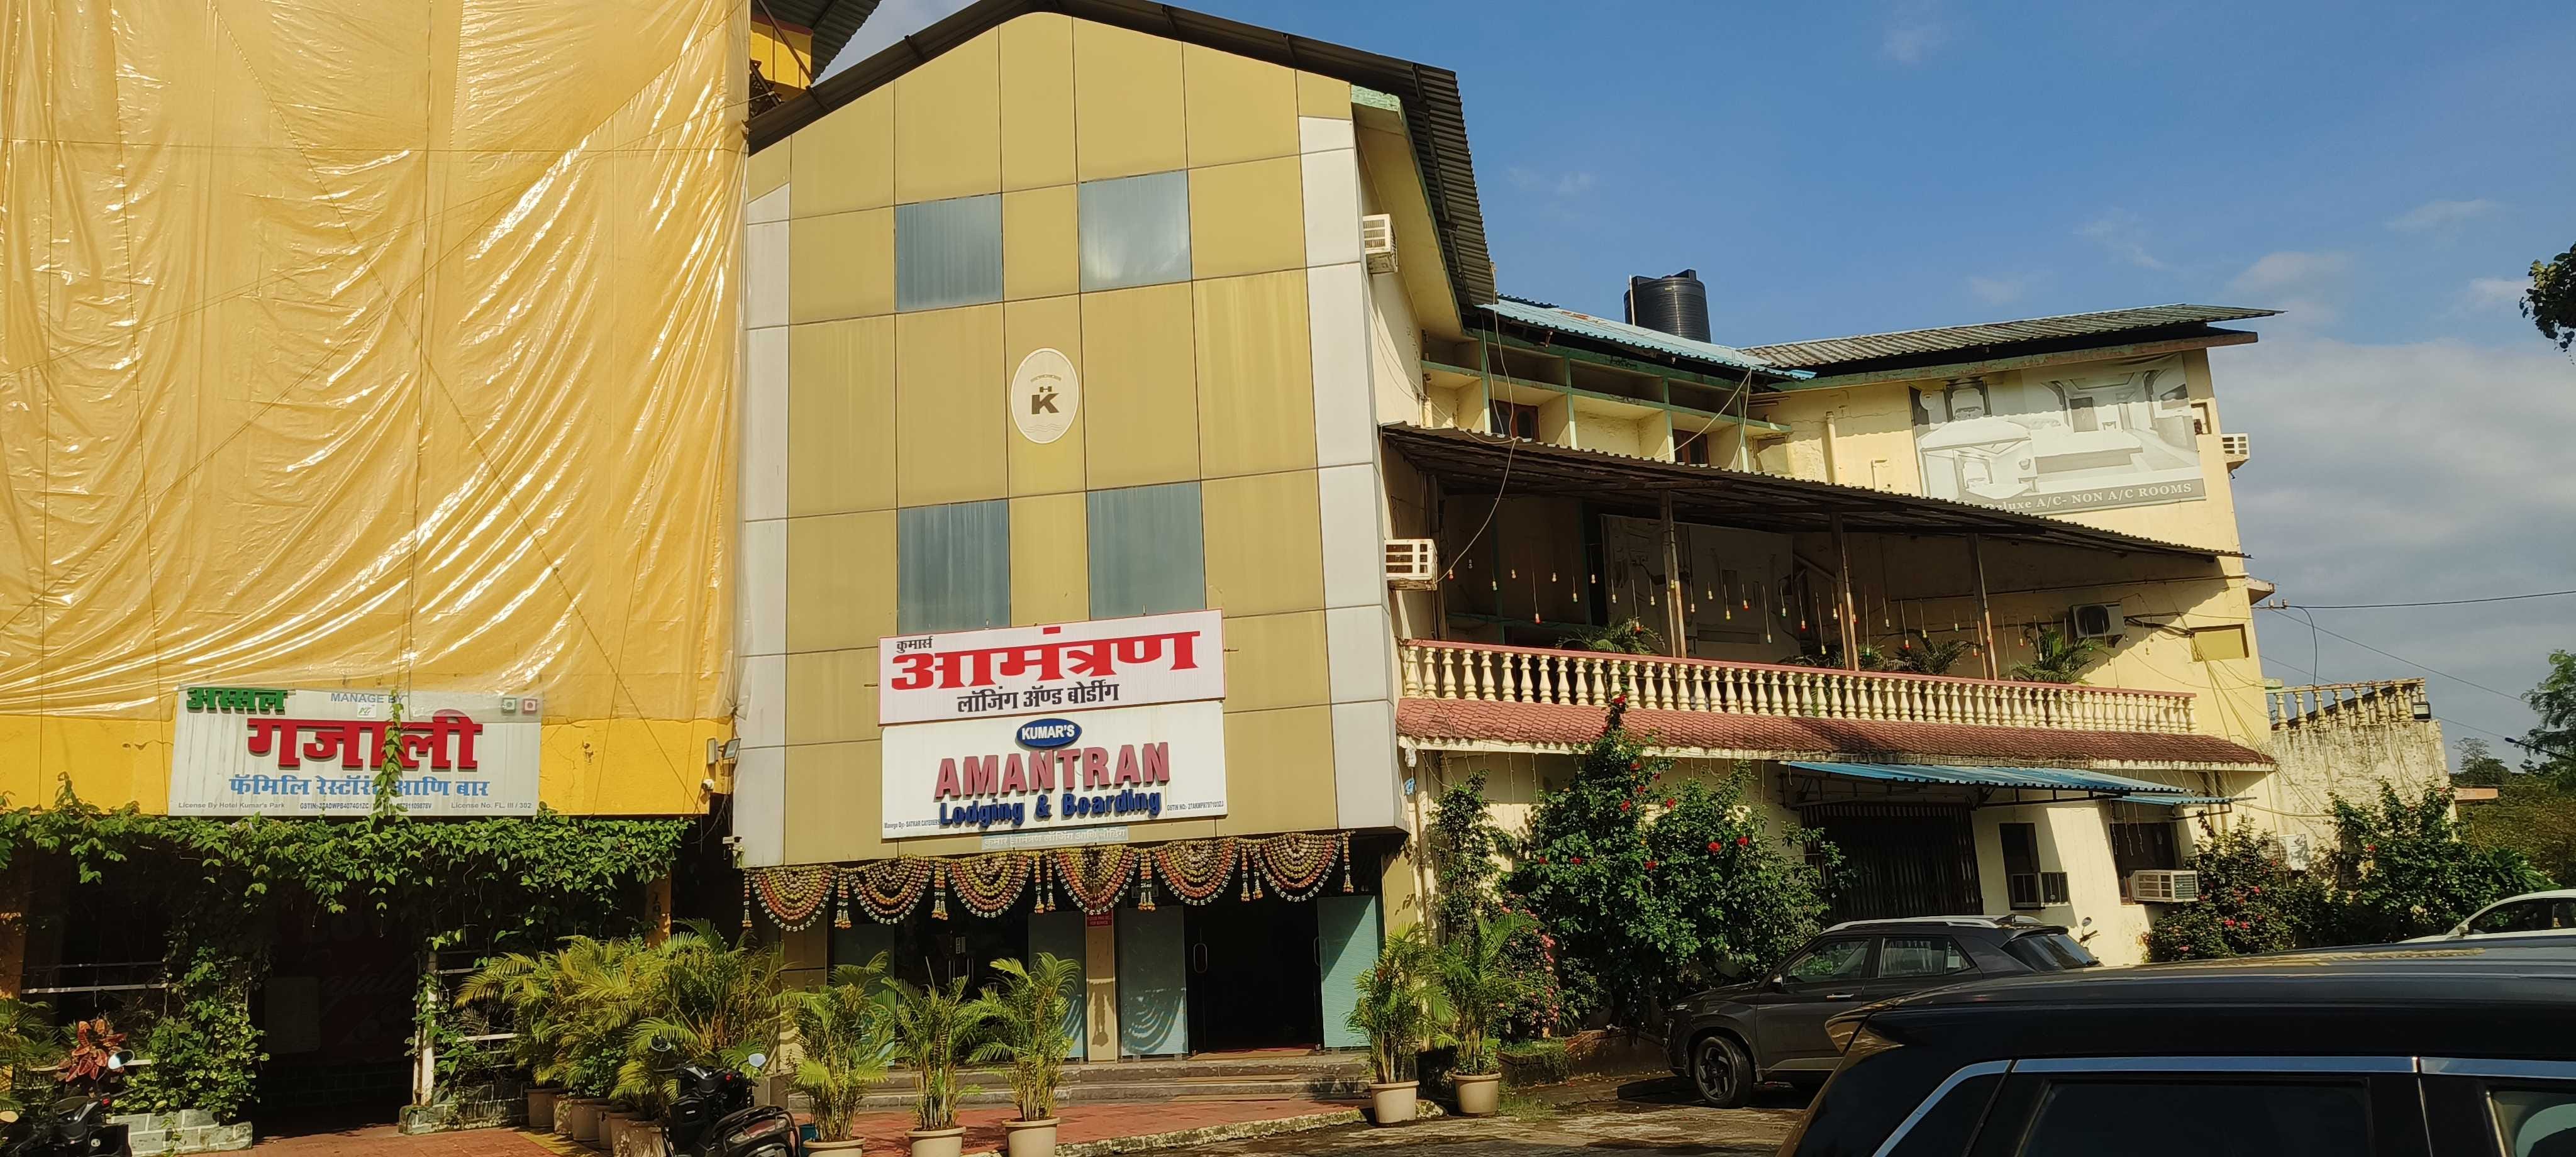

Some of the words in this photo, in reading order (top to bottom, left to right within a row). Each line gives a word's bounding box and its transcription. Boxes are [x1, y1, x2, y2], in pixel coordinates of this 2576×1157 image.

[1031, 393, 1060, 414] K
[2038, 495, 2067, 509] A/C-
[2072, 492, 2103, 504] NON
[2108, 489, 2134, 502] A/C
[2139, 483, 2192, 498] ROOMS
[896, 636, 933, 652] कुमार्स
[892, 626, 1201, 690] आमंत्रण
[186, 687, 288, 712] अस्सल
[331, 693, 384, 704] MANAGE
[388, 694, 403, 704] BY
[957, 686, 1018, 712] लॉजिंग
[247, 709, 483, 770] गजाली
[1021, 724, 1075, 740] KUMAR'S
[935, 742, 1170, 799] AMANTRAN
[229, 774, 312, 795] फॅमिलि
[456, 781, 491, 797] बार
[940, 800, 1025, 828] Lodging
[1035, 794, 1052, 818] &
[1062, 789, 1162, 816] Boarding
